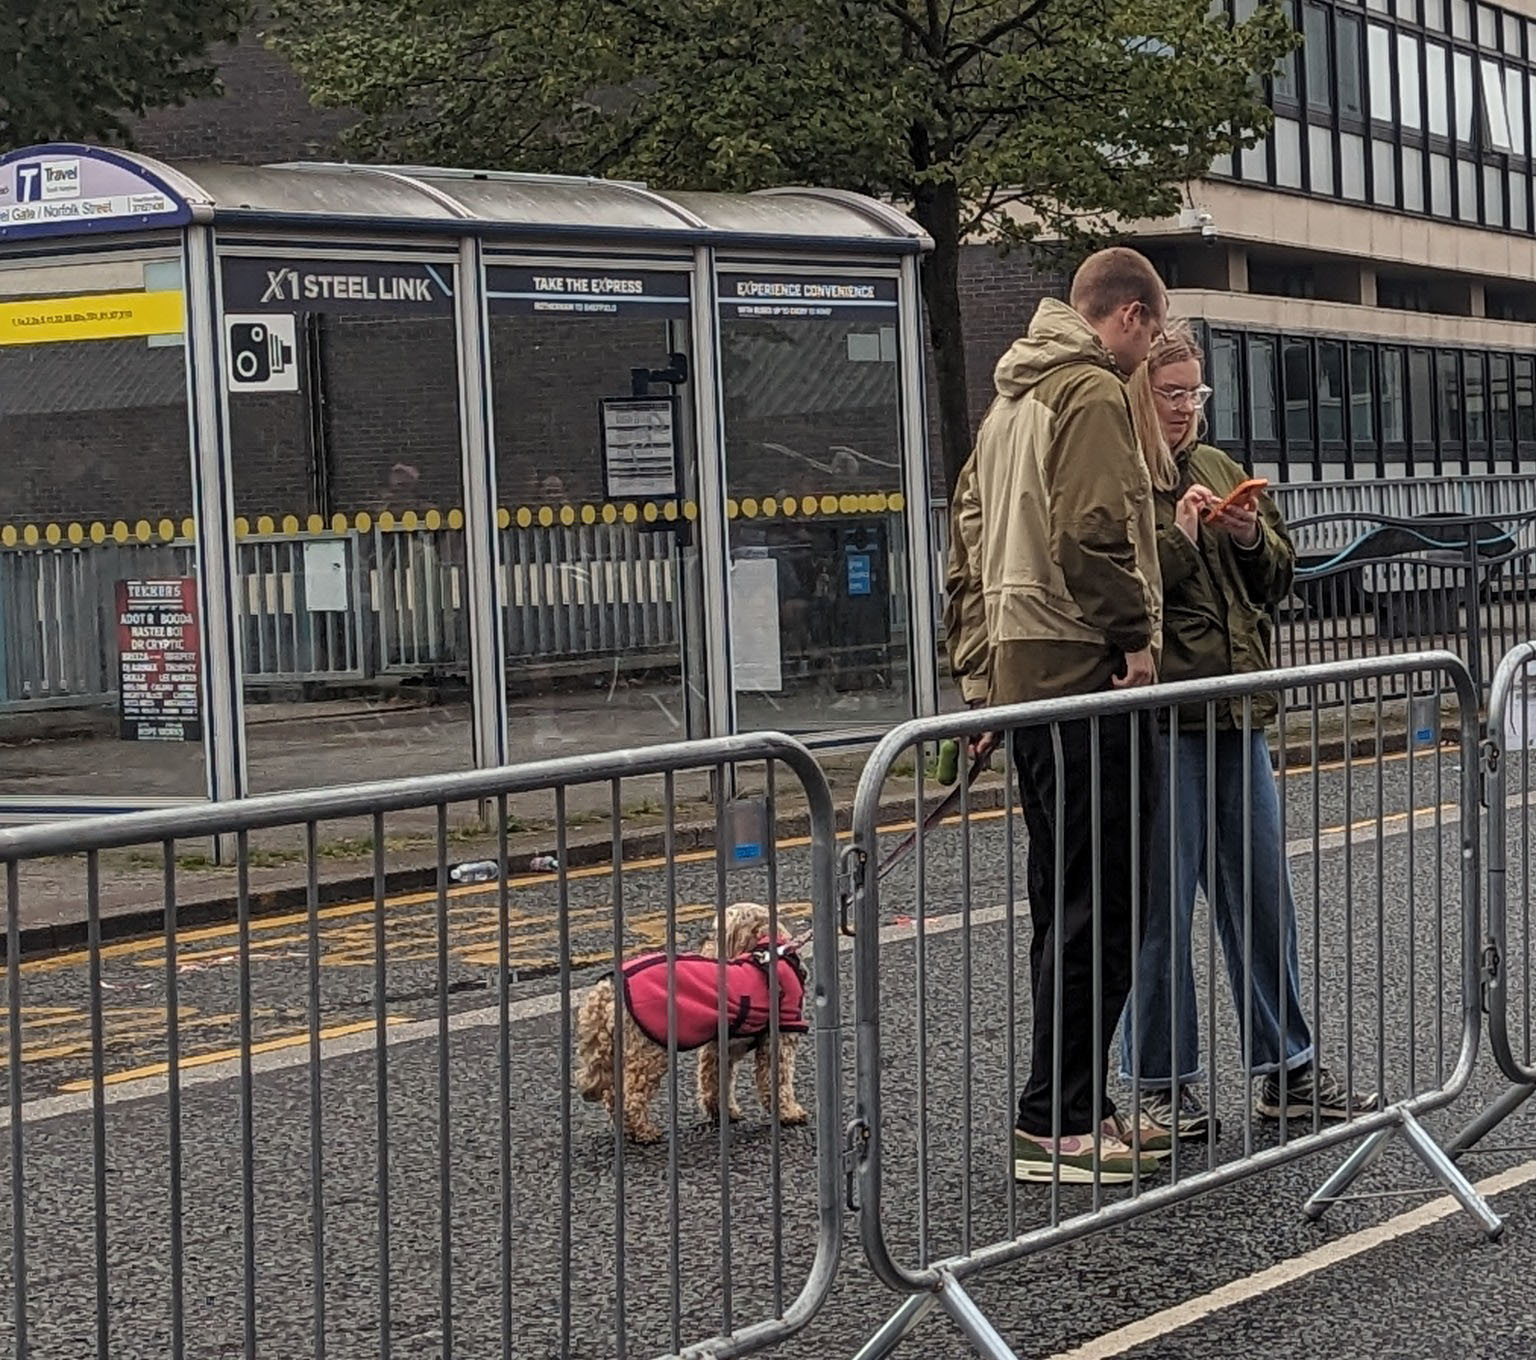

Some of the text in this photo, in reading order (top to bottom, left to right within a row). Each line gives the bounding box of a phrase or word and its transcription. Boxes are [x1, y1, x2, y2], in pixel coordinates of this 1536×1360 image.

[44, 166, 78, 182] Travel
[11, 207, 36, 221] Gate
[43, 202, 80, 218] Norfolk
[82, 199, 113, 215] Street
[260, 268, 300, 303] X1
[532, 276, 643, 294] TAKE THE EXPRESS
[736, 280, 875, 299] EXPERIENCE CONVENIENCE
